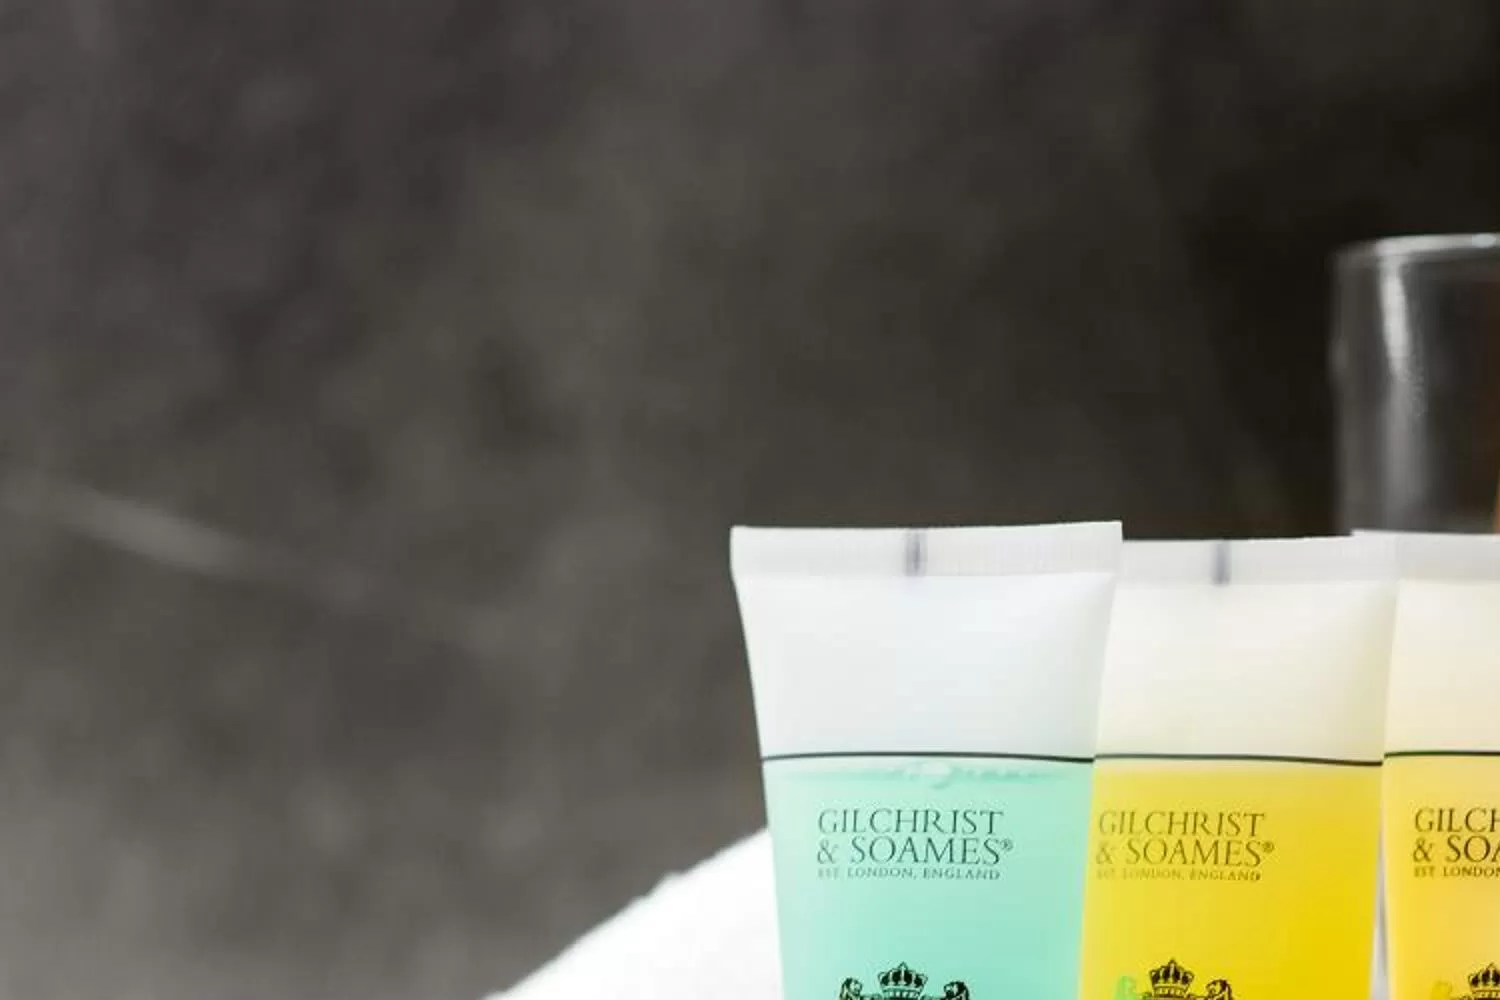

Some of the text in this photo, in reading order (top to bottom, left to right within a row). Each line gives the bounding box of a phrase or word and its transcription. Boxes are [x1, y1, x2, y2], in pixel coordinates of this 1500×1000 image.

[818, 807, 1004, 834] GILCHRIST
[1099, 810, 1265, 838] GILCHRIST
[817, 839, 838, 865] &
[1096, 841, 1114, 865] &
[1413, 837, 1435, 863] &
[923, 867, 1001, 881] ENGLAND
[1190, 868, 1262, 882] ENGLAND
